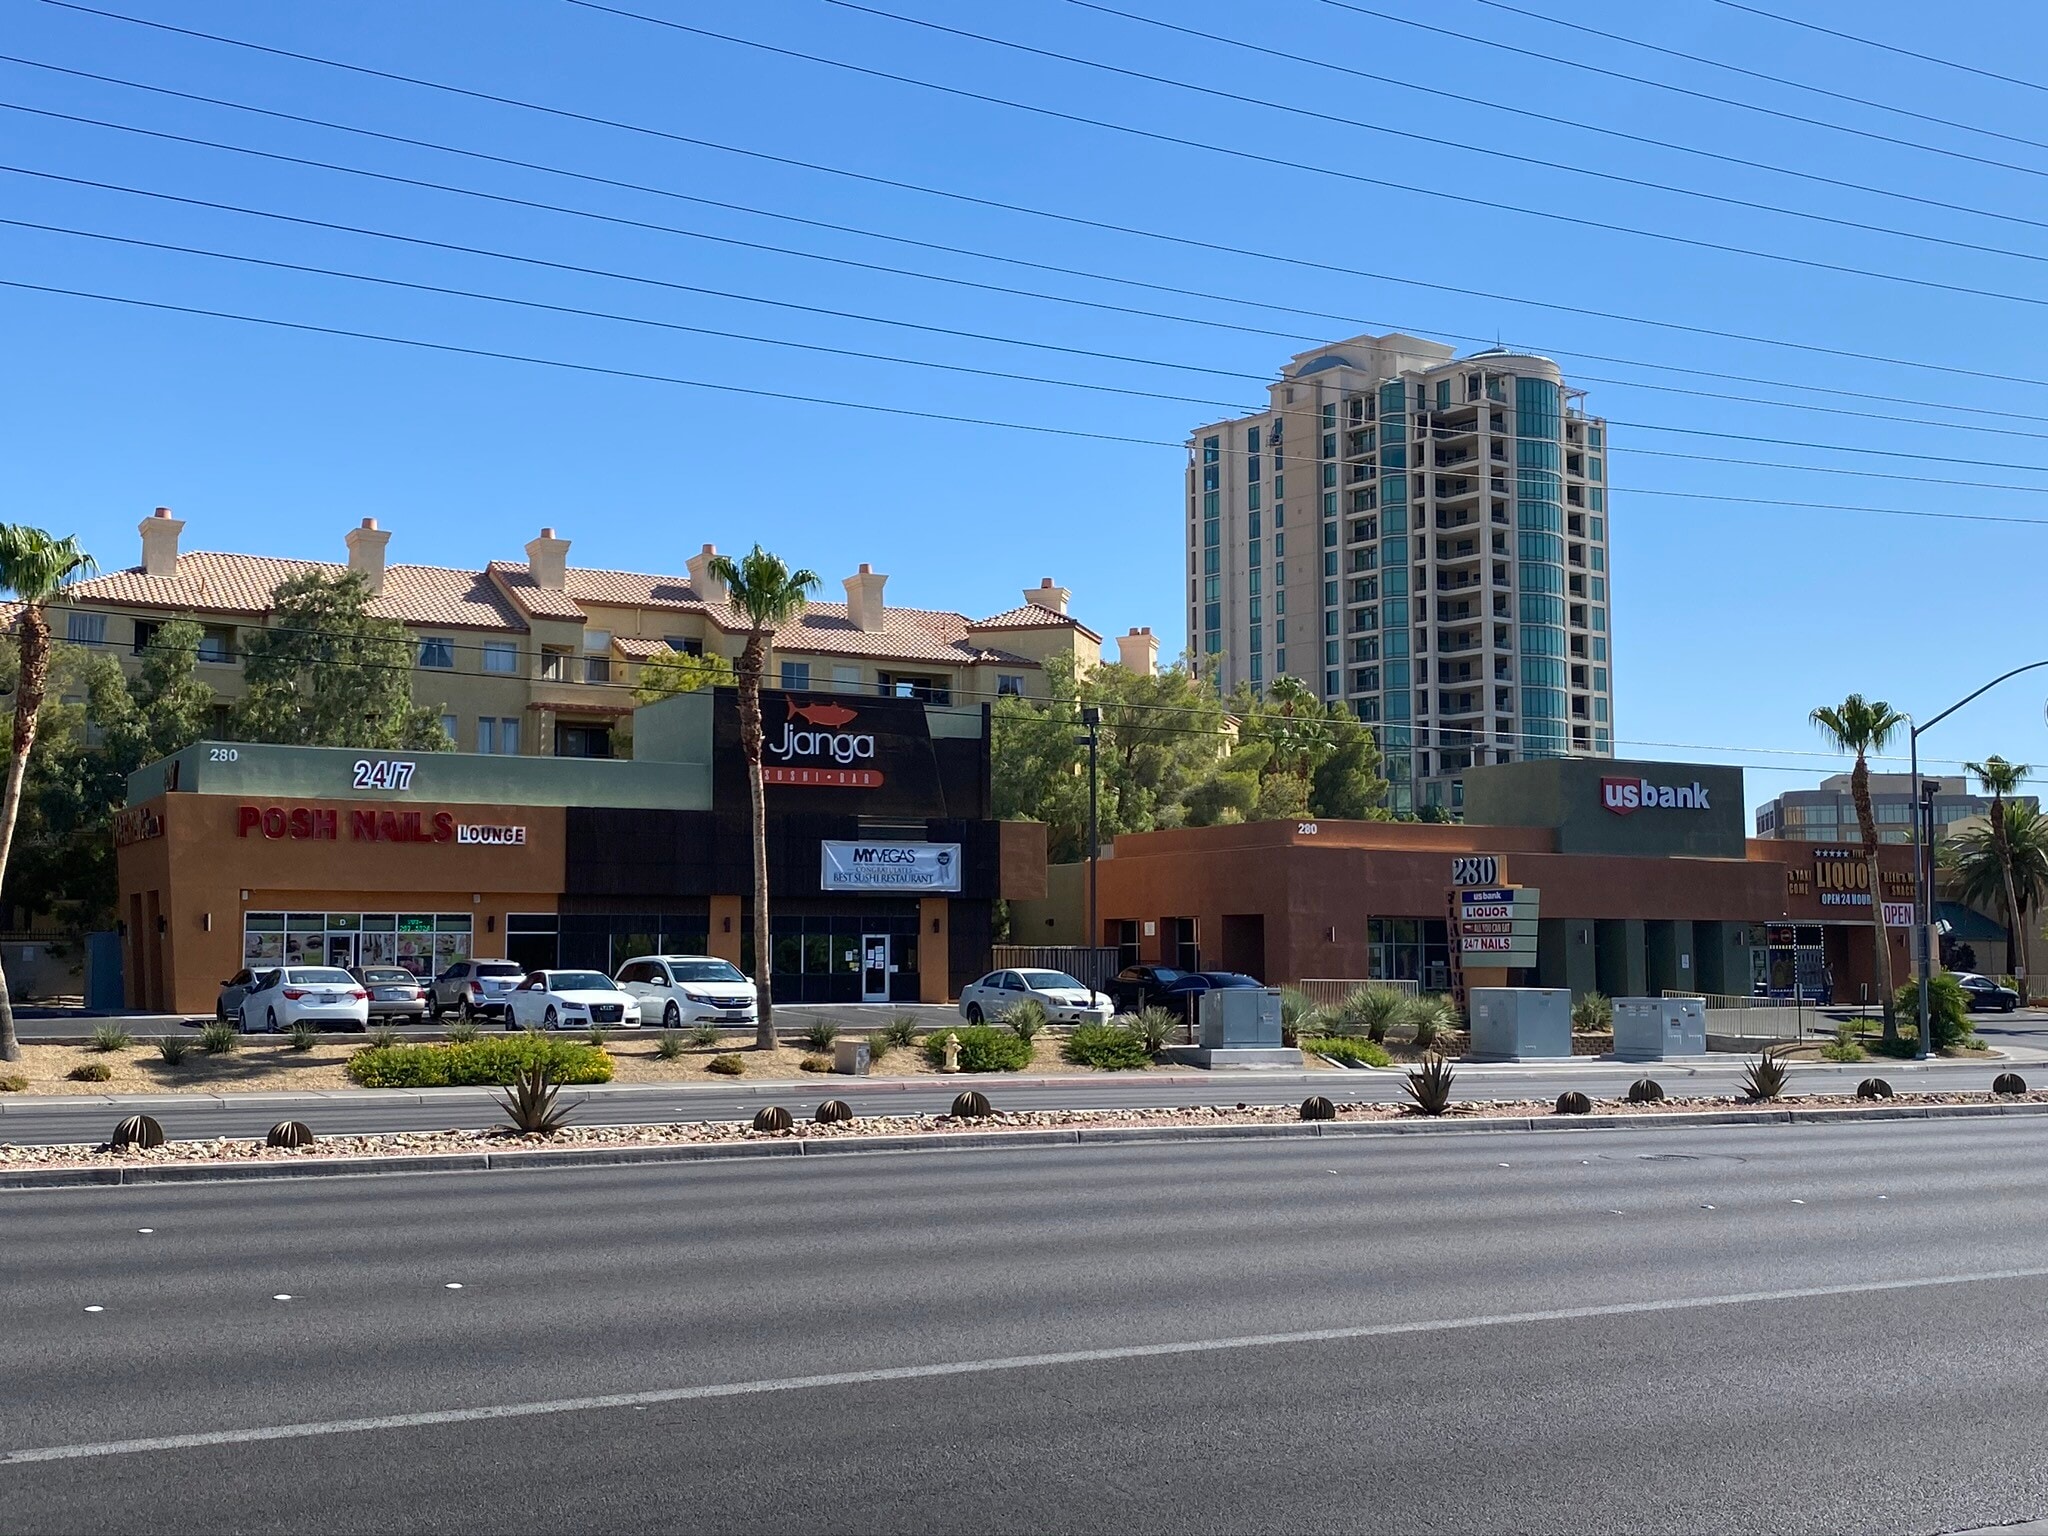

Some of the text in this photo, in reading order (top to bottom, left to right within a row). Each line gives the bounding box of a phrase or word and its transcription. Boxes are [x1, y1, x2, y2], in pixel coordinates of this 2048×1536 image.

[769, 722, 874, 763] Jjanga
[209, 748, 238, 762] 280
[353, 760, 415, 790] 24/7
[764, 769, 869, 784] SUSHI BAR
[236, 806, 526, 845] POSH NAILS LOUNGE
[1298, 823, 1317, 834] 280
[833, 872, 852, 882] BEST
[881, 874, 934, 884] RESTAURANT
[1453, 857, 1496, 887] 280
[1795, 869, 1812, 881] TAXI
[1815, 862, 1868, 890] LIQUO
[1821, 893, 1872, 905] OPEN 24 HOUR
[1466, 907, 1508, 917] LIQUOR
[1884, 905, 1911, 924] OPEN
[1464, 938, 1510, 949] 24/7 NAILS
